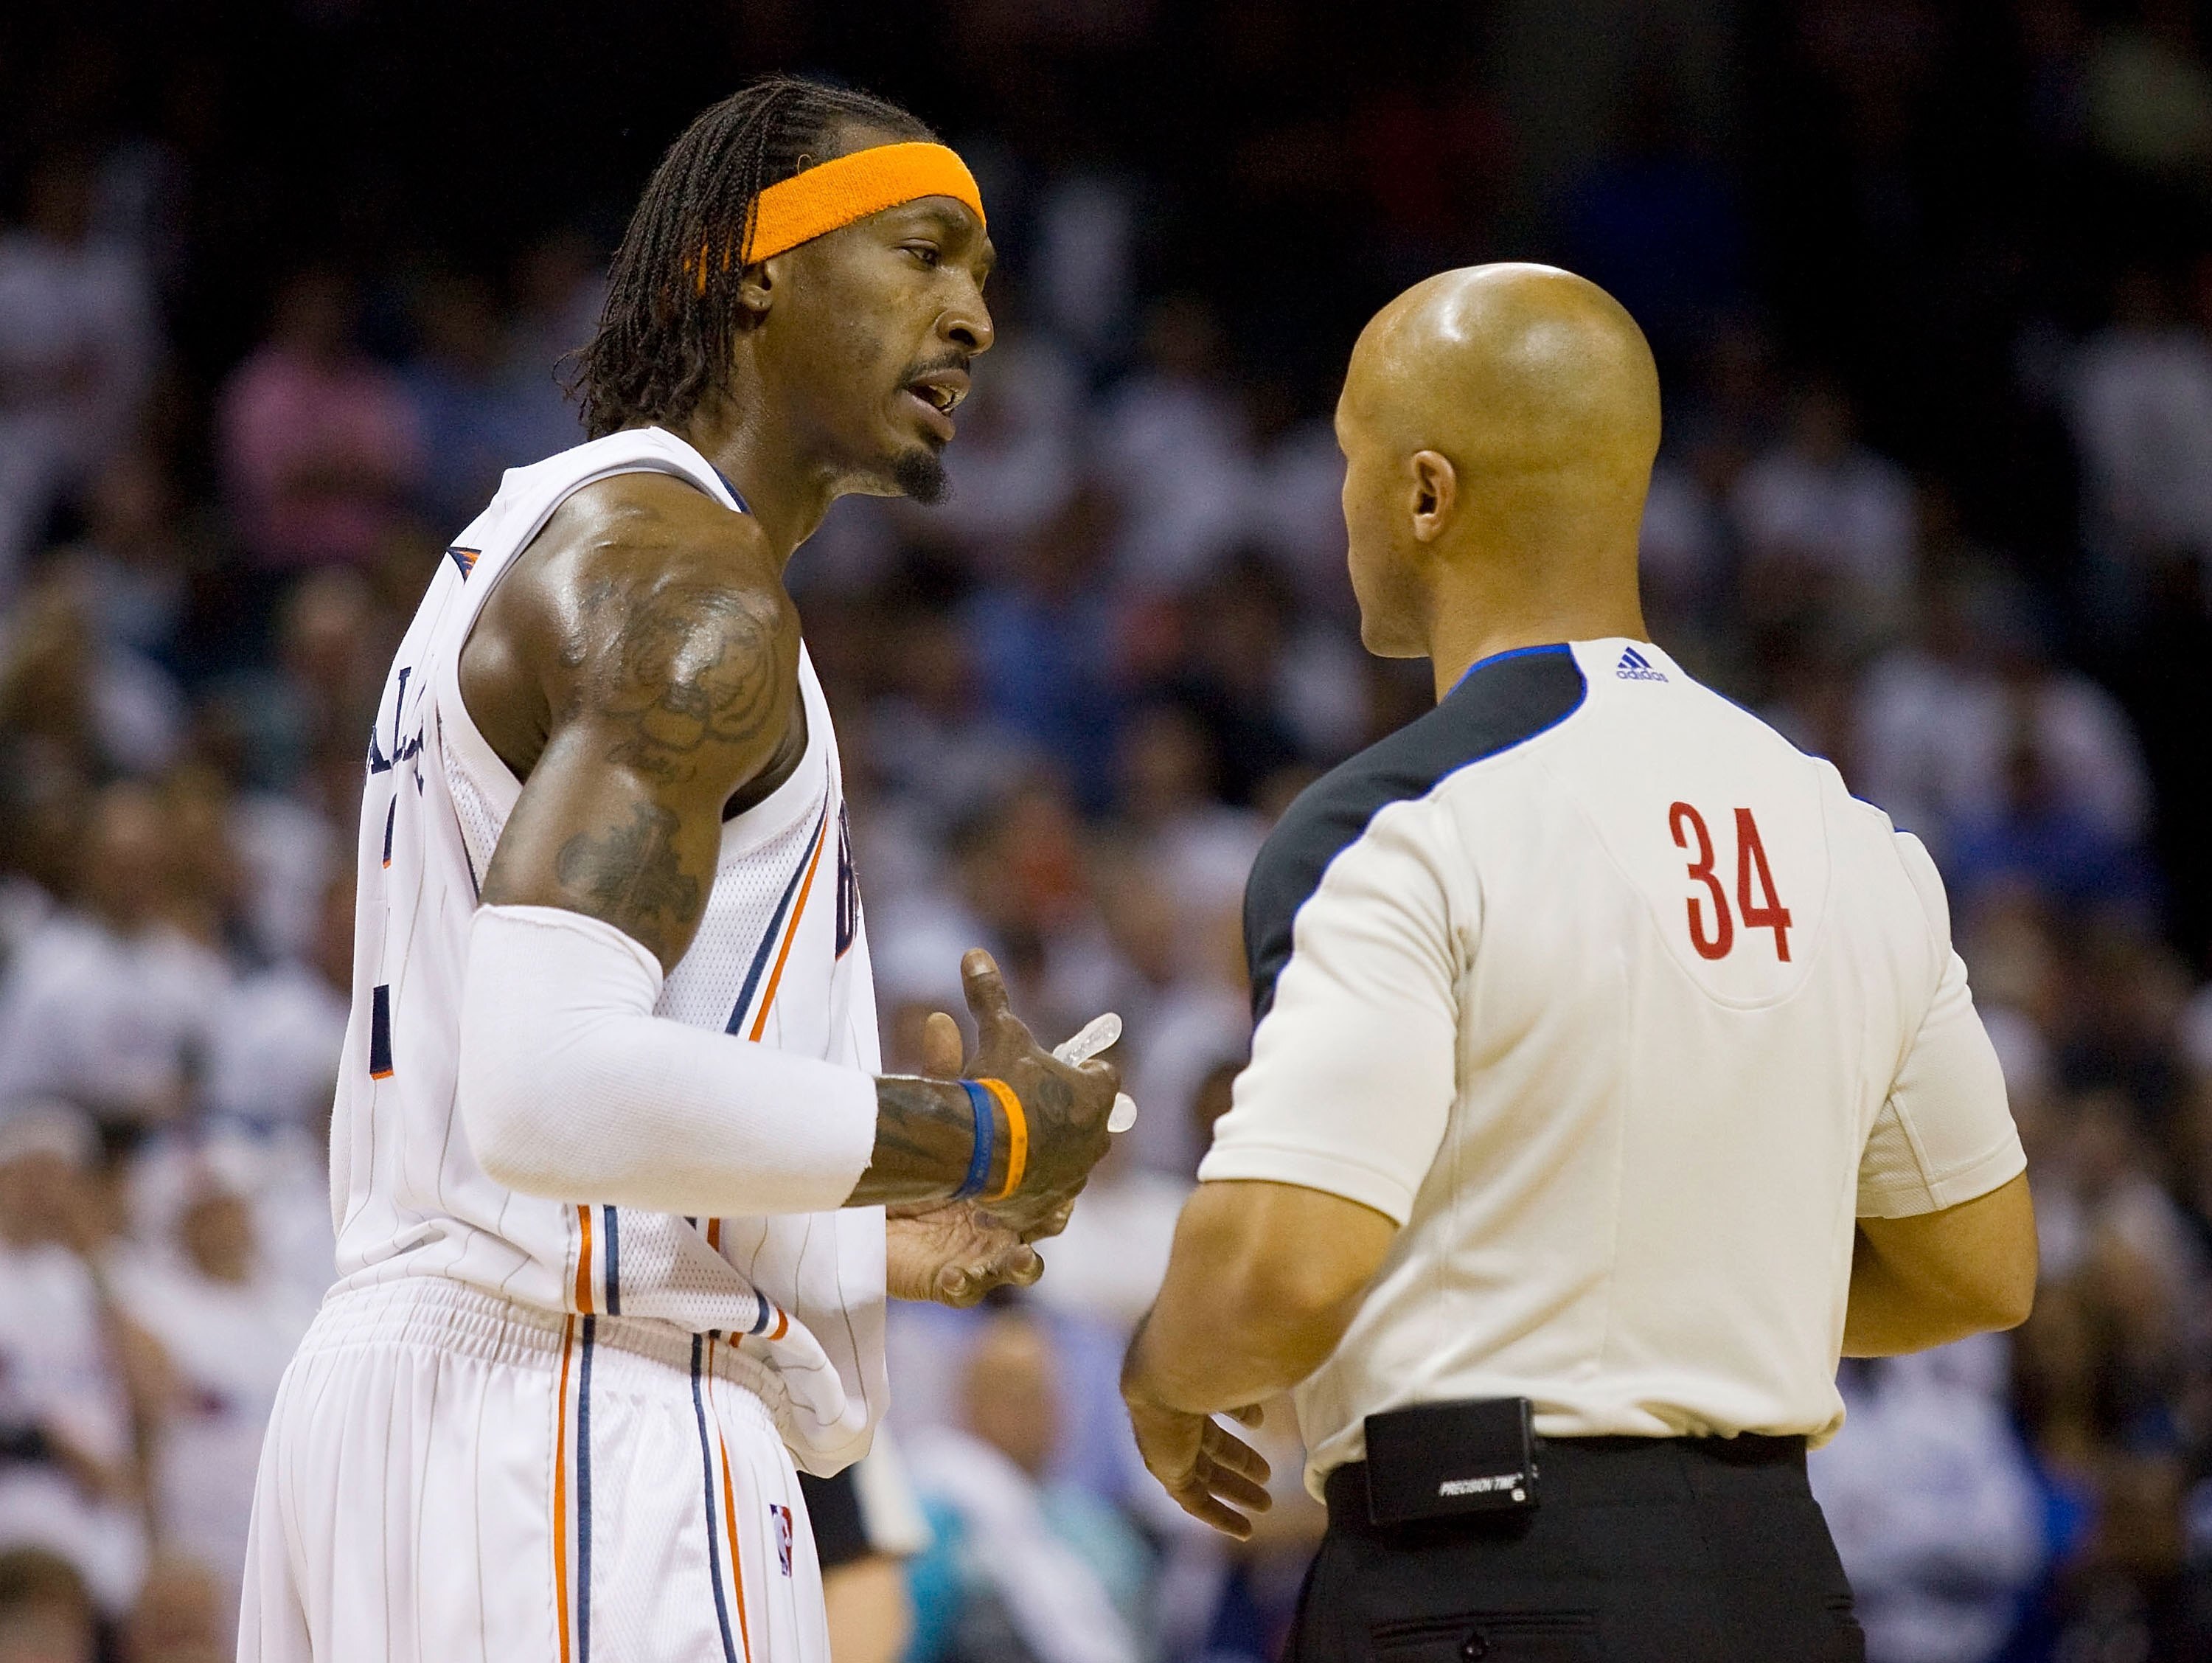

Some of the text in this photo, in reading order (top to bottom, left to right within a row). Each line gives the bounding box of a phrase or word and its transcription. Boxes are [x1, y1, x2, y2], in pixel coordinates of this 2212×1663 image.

[1616, 667, 1669, 683] adidas
[1669, 801, 1793, 962] 34
[1439, 1477, 1492, 1497] PRECISION
